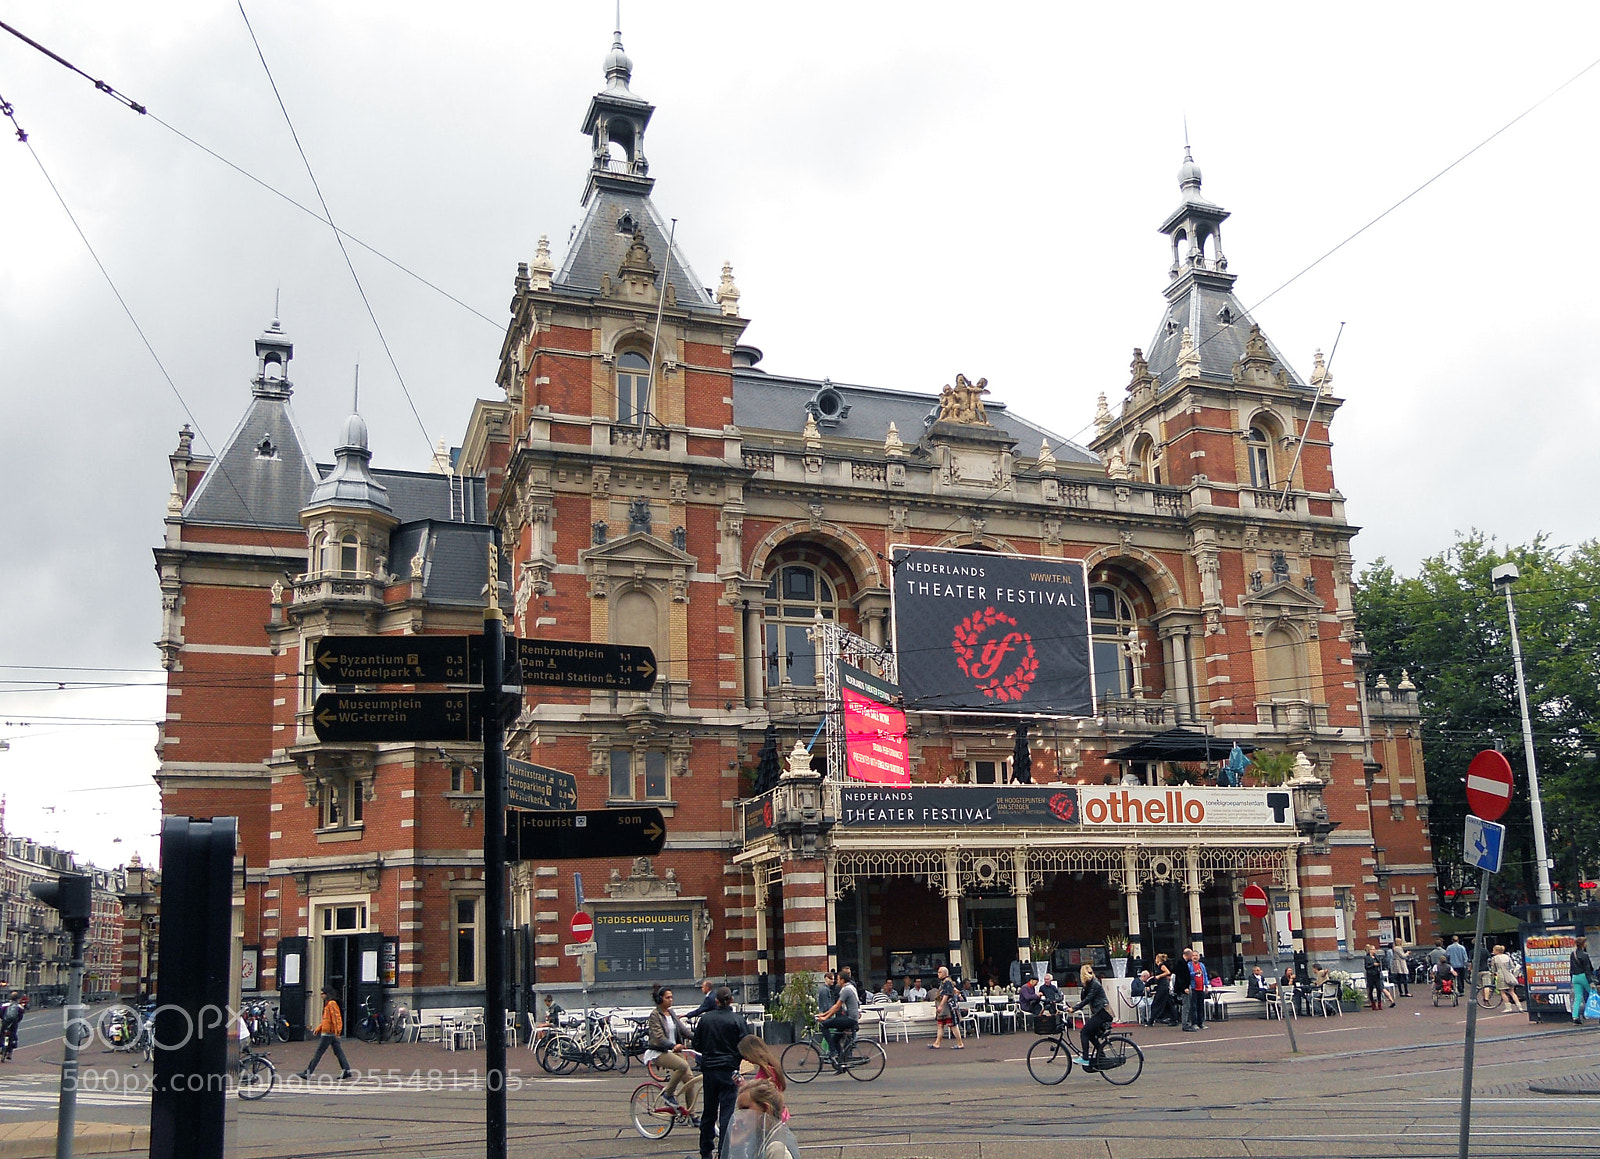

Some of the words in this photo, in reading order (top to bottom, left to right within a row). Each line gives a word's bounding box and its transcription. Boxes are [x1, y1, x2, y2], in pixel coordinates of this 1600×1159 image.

[906, 562, 985, 577] NEDERLANDS
[1030, 572, 1073, 585] WWW.TF.NL
[907, 581, 987, 600] THEATER
[996, 588, 1077, 607] FESTIVAL
[521, 645, 605, 660] Rembrandtplein
[340, 654, 404, 667] Byzantium
[521, 658, 545, 668] Dam
[340, 667, 411, 679] Vondelpark
[521, 670, 564, 681] Centraal
[567, 672, 604, 683] Station
[339, 699, 422, 711] Museumplein
[338, 712, 407, 722] WG-terrein
[509, 764, 548, 782] Marnixstraat
[509, 776, 546, 796] Europarking
[845, 792, 913, 801] NEDERLANDS
[1085, 790, 1205, 824] othello
[522, 816, 573, 827] i-tourist
[618, 815, 642, 825] 50m
[846, 808, 915, 821] THEATER
[923, 808, 992, 821] FESTIVAL
